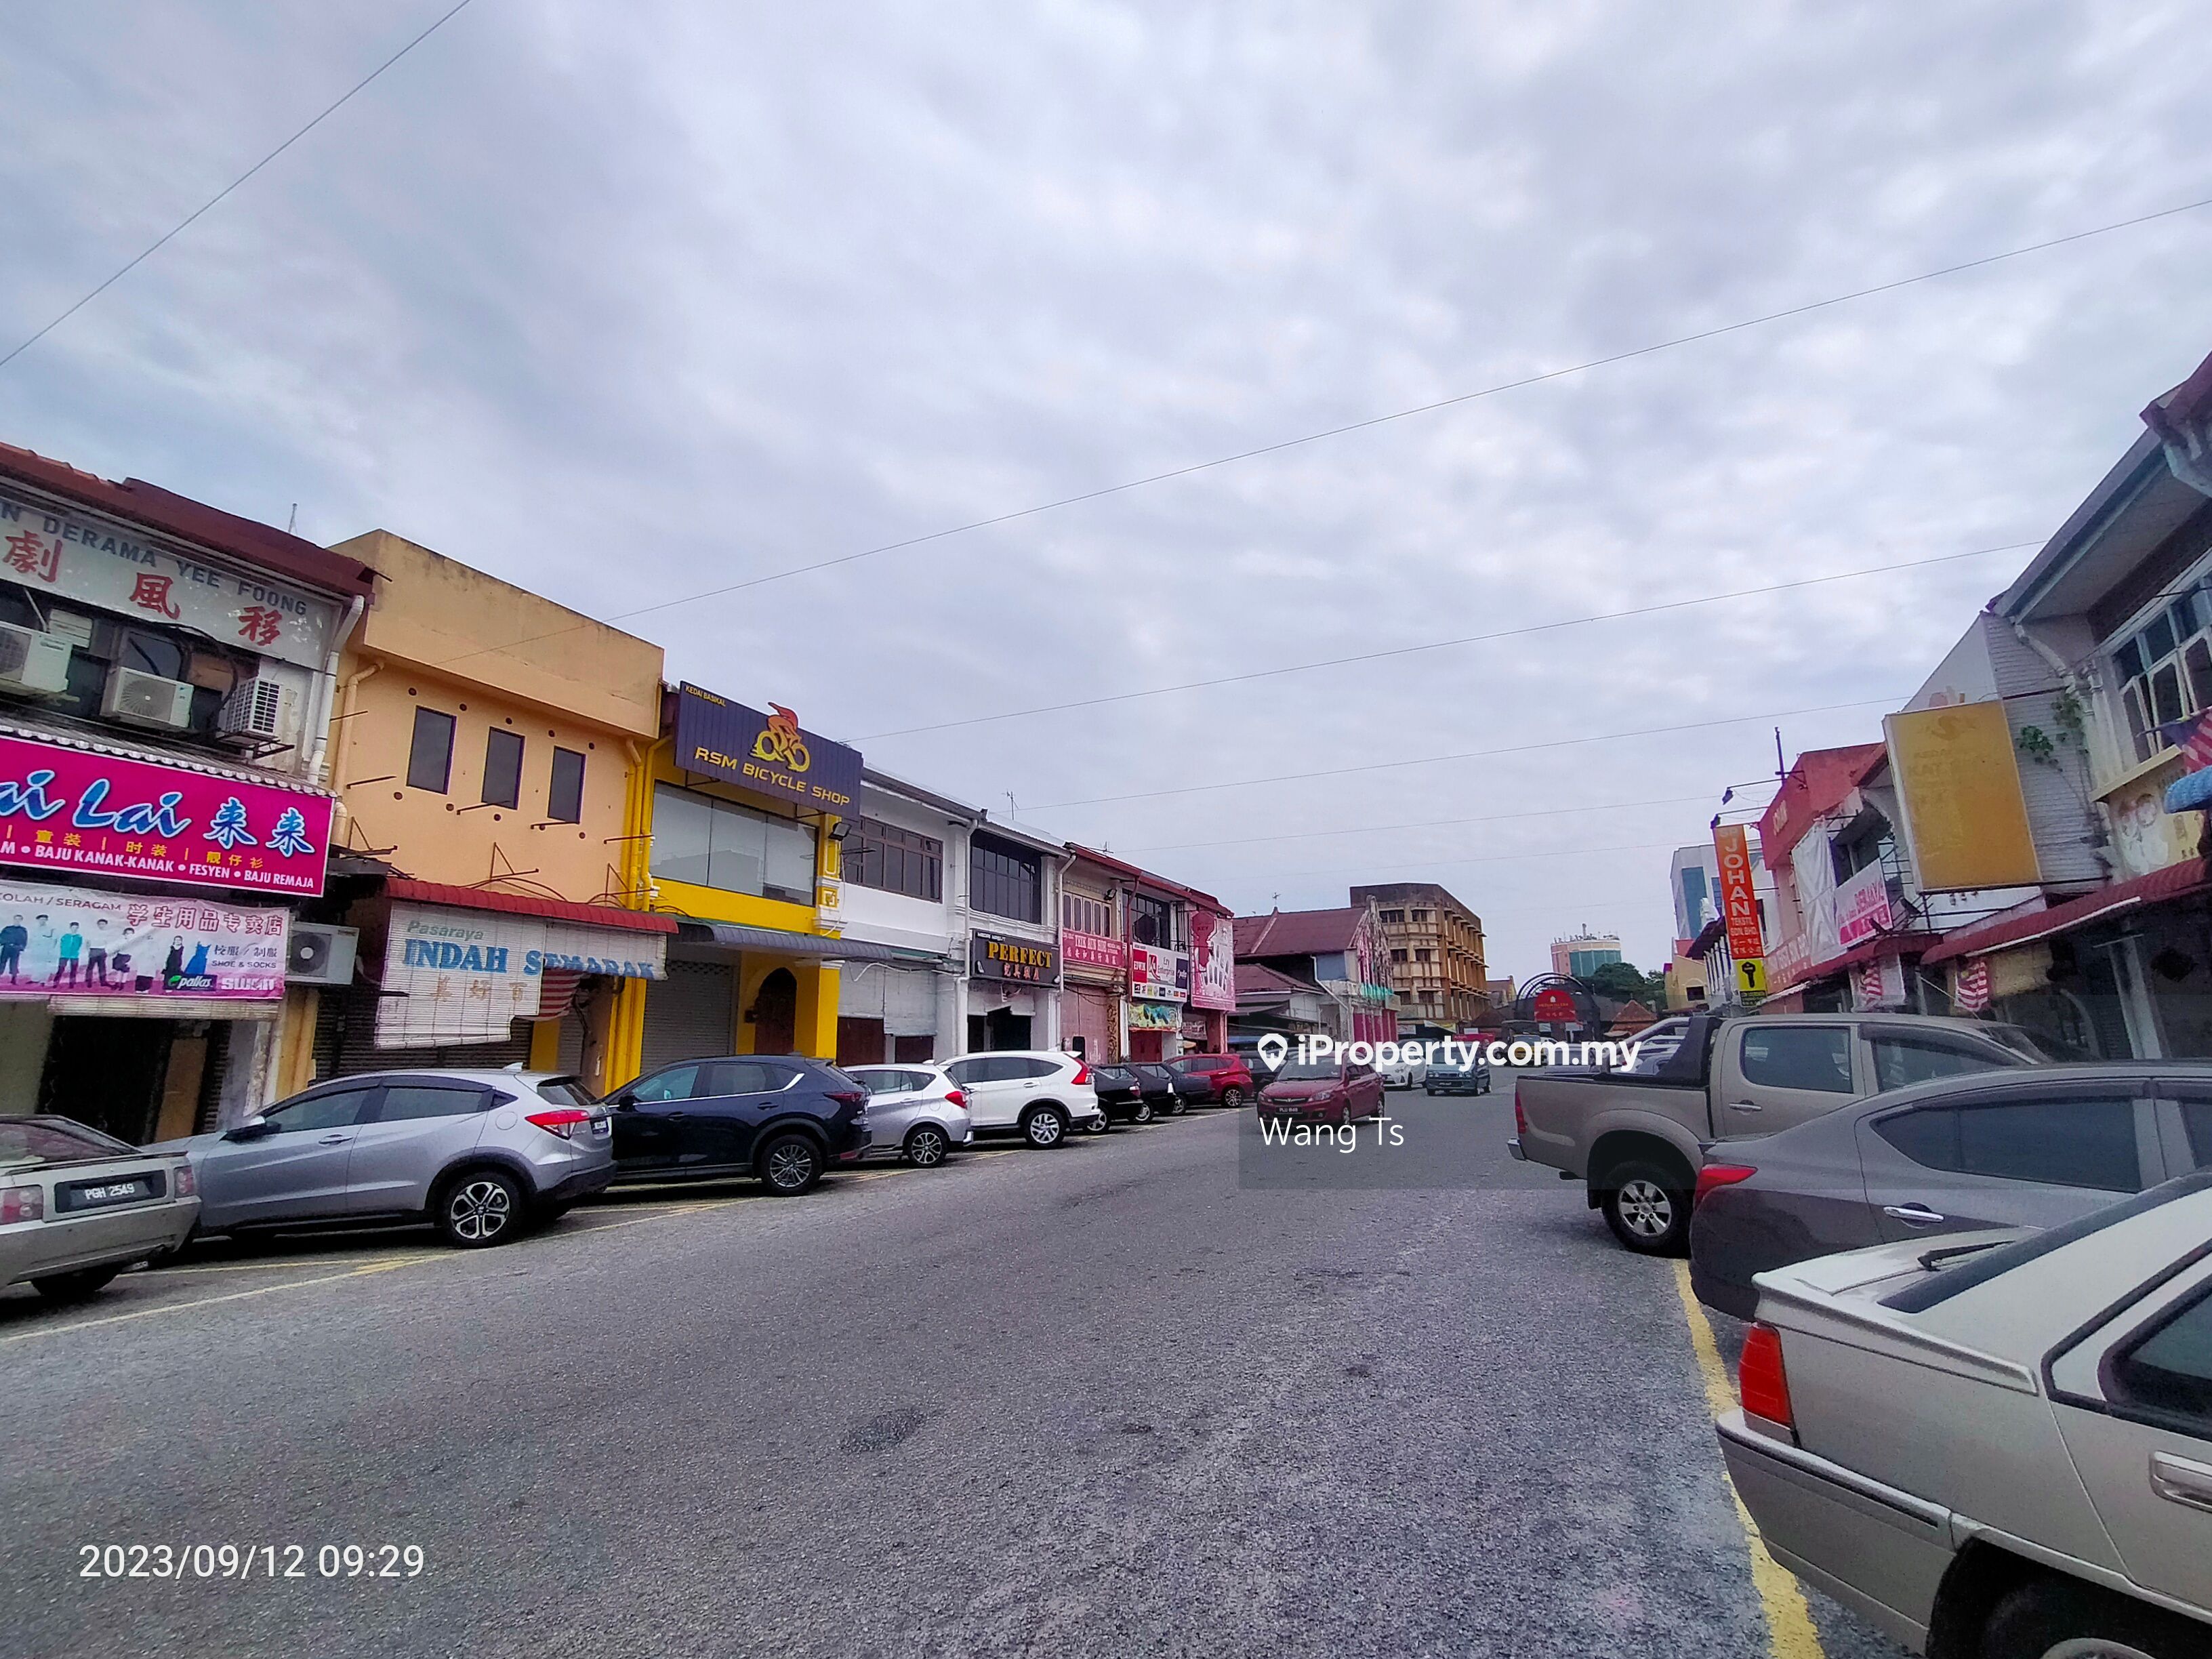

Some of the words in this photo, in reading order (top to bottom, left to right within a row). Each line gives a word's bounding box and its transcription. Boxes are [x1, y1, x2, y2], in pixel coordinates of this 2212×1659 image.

[43, 516, 157, 568] DERAMA
[176, 560, 221, 588] YEE
[238, 580, 306, 615] FOONG
[685, 685, 703, 697] KEDAI
[695, 746, 737, 770] RSM
[743, 762, 806, 792] BICYCLE
[811, 785, 850, 806] SHOP
[73, 779, 192, 838] Lai
[35, 845, 71, 861] BAJU
[74, 850, 173, 872] KANAK-KANAK
[189, 863, 230, 878] FESYEN
[244, 870, 271, 884] BAJU
[272, 874, 314, 888] REMAJA
[125, 841, 167, 857] 时装
[207, 851, 263, 869] 靓仔衫
[1724, 838, 1750, 916] JOHAN
[56, 898, 121, 910] SERAGAM
[127, 903, 283, 936] 学生用品专卖店
[407, 920, 484, 941] Pasaraya
[403, 939, 509, 973] INDAH
[523, 950, 655, 980] SEMARAK
[987, 941, 1052, 968] PERFECT
[85, 1188, 106, 1200] PGH
[110, 1183, 135, 1197] 2549
